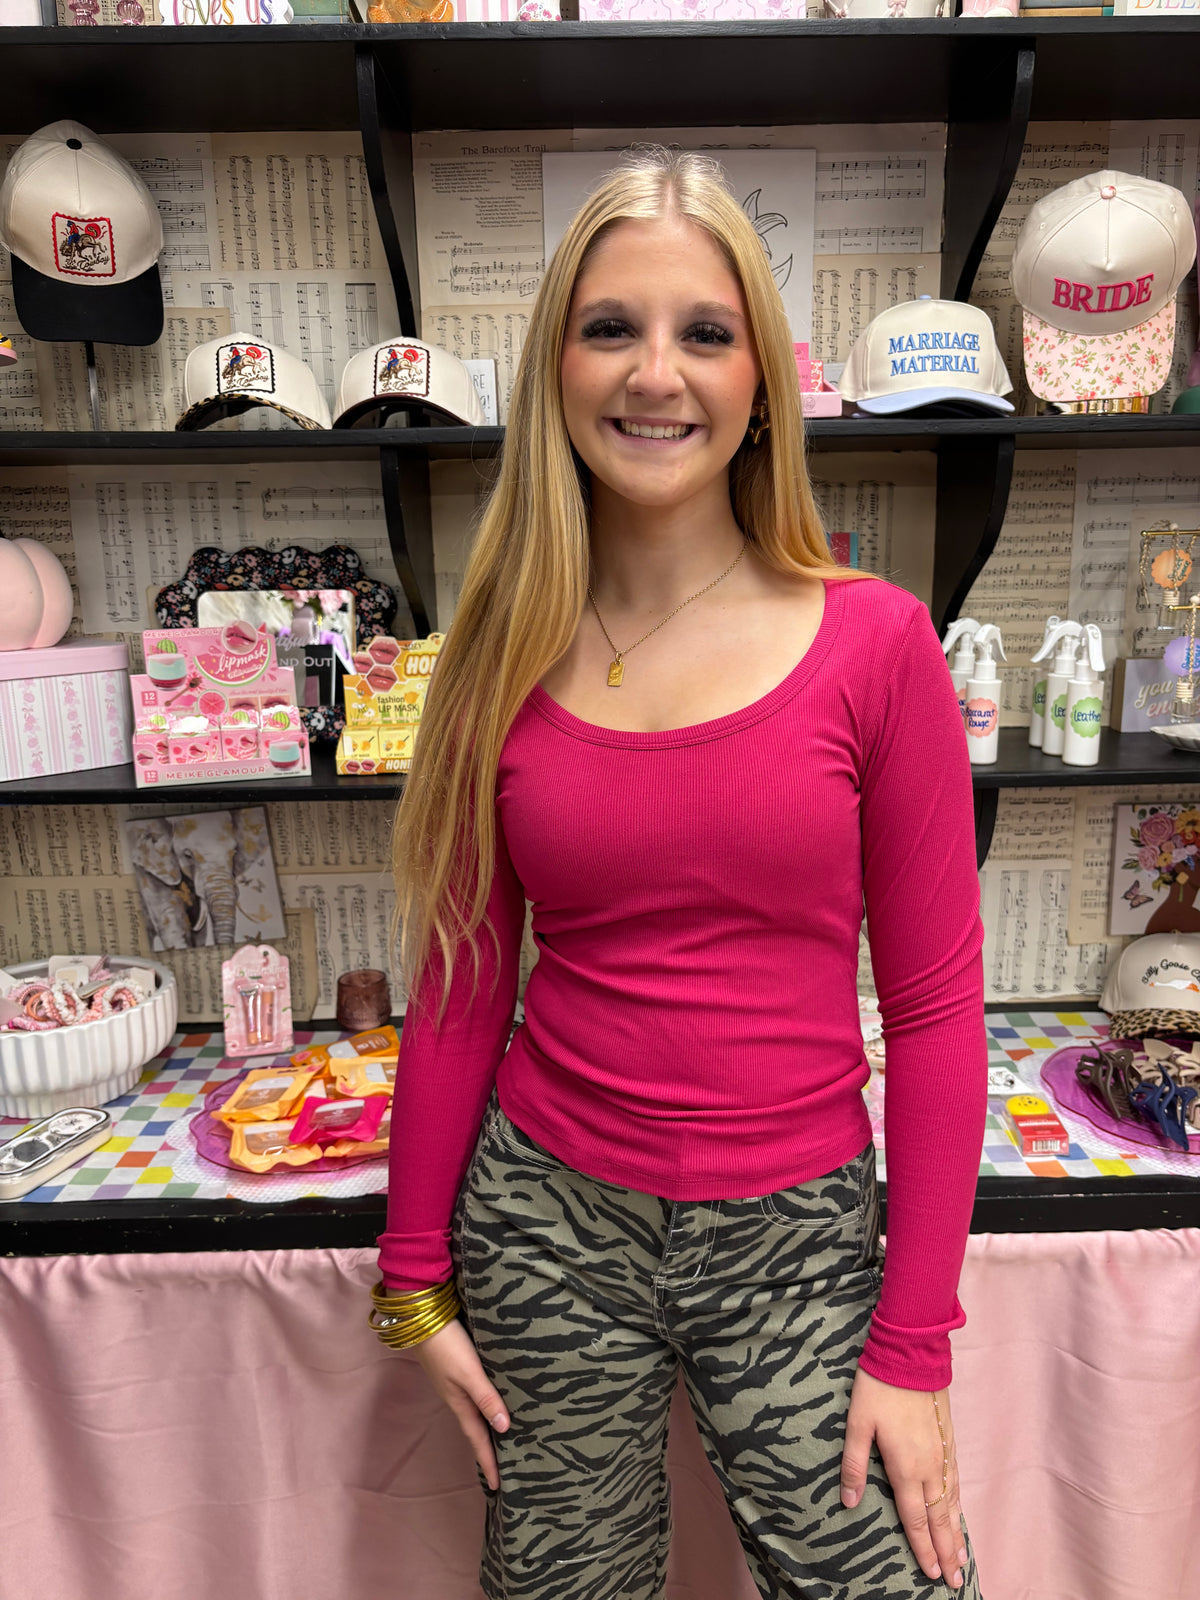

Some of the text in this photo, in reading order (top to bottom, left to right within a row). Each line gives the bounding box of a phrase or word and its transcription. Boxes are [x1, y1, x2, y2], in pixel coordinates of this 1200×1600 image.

[1052, 272, 1155, 314] BRIDE
[888, 331, 981, 355] MARRIAGE
[890, 354, 980, 377] MATERIAL
[303, 656, 332, 667] OUT
[144, 692, 155, 701] 12
[377, 696, 405, 704] fashion
[1134, 680, 1174, 710] you
[378, 703, 418, 713] LIP MASK
[968, 716, 990, 731] Rouge
[166, 770, 205, 780] MEIKE
[206, 766, 266, 778] GLAMOUR
[1160, 958, 1190, 971] Goose
